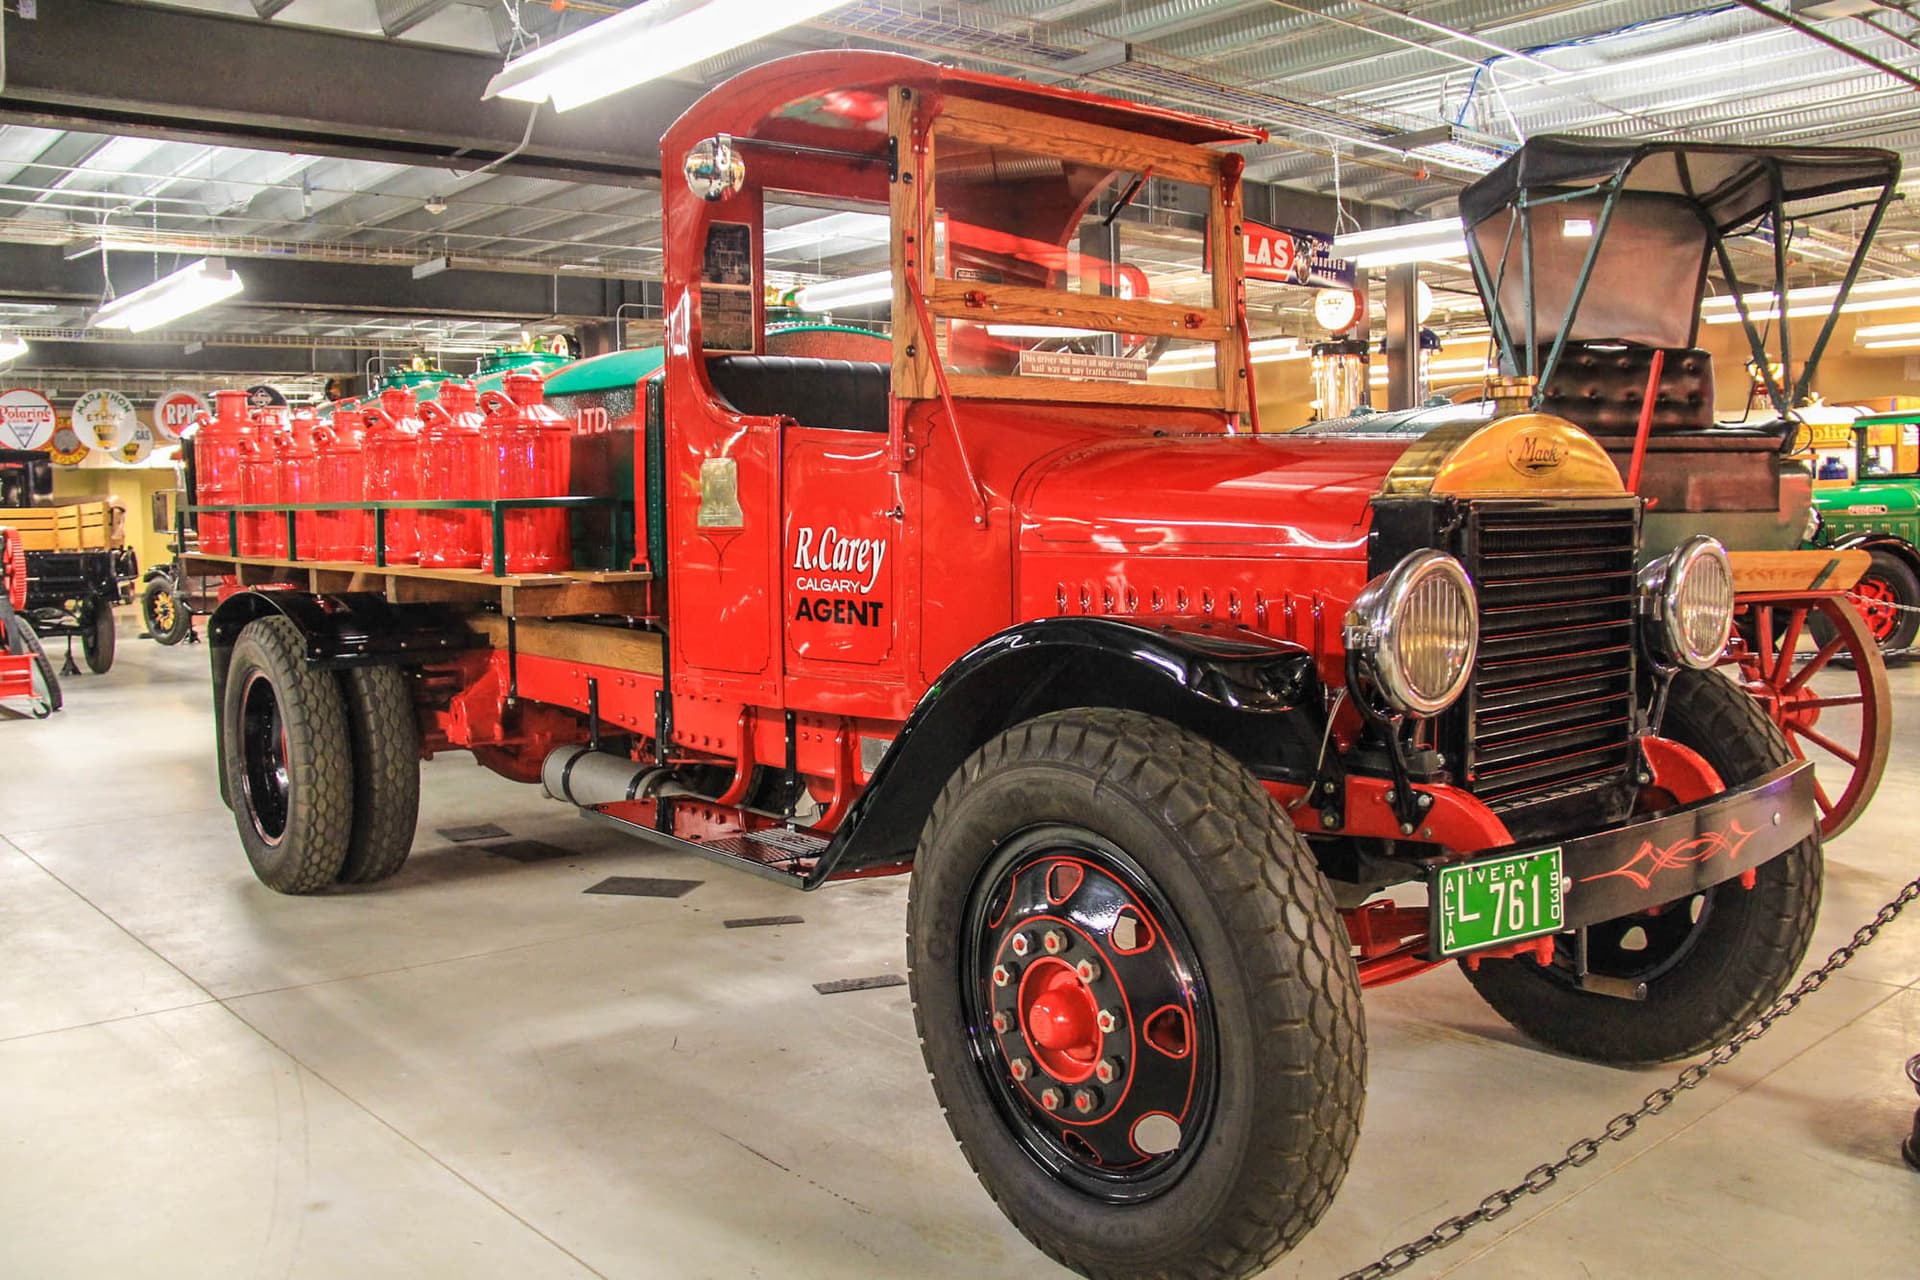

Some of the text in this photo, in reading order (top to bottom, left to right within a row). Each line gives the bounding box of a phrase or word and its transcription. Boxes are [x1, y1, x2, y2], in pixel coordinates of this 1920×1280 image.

[1243, 235, 1288, 269] LAS
[1086, 367, 1107, 377] traffic
[76, 392, 131, 415] MARATHON
[577, 406, 612, 435] LTD.
[1517, 437, 1560, 462] Mack
[796, 577, 860, 594] CALGARY
[795, 597, 884, 627] AGENT
[1549, 855, 1561, 920] 1930
[1444, 877, 1456, 946] ALTA
[1488, 874, 1540, 937] 761
